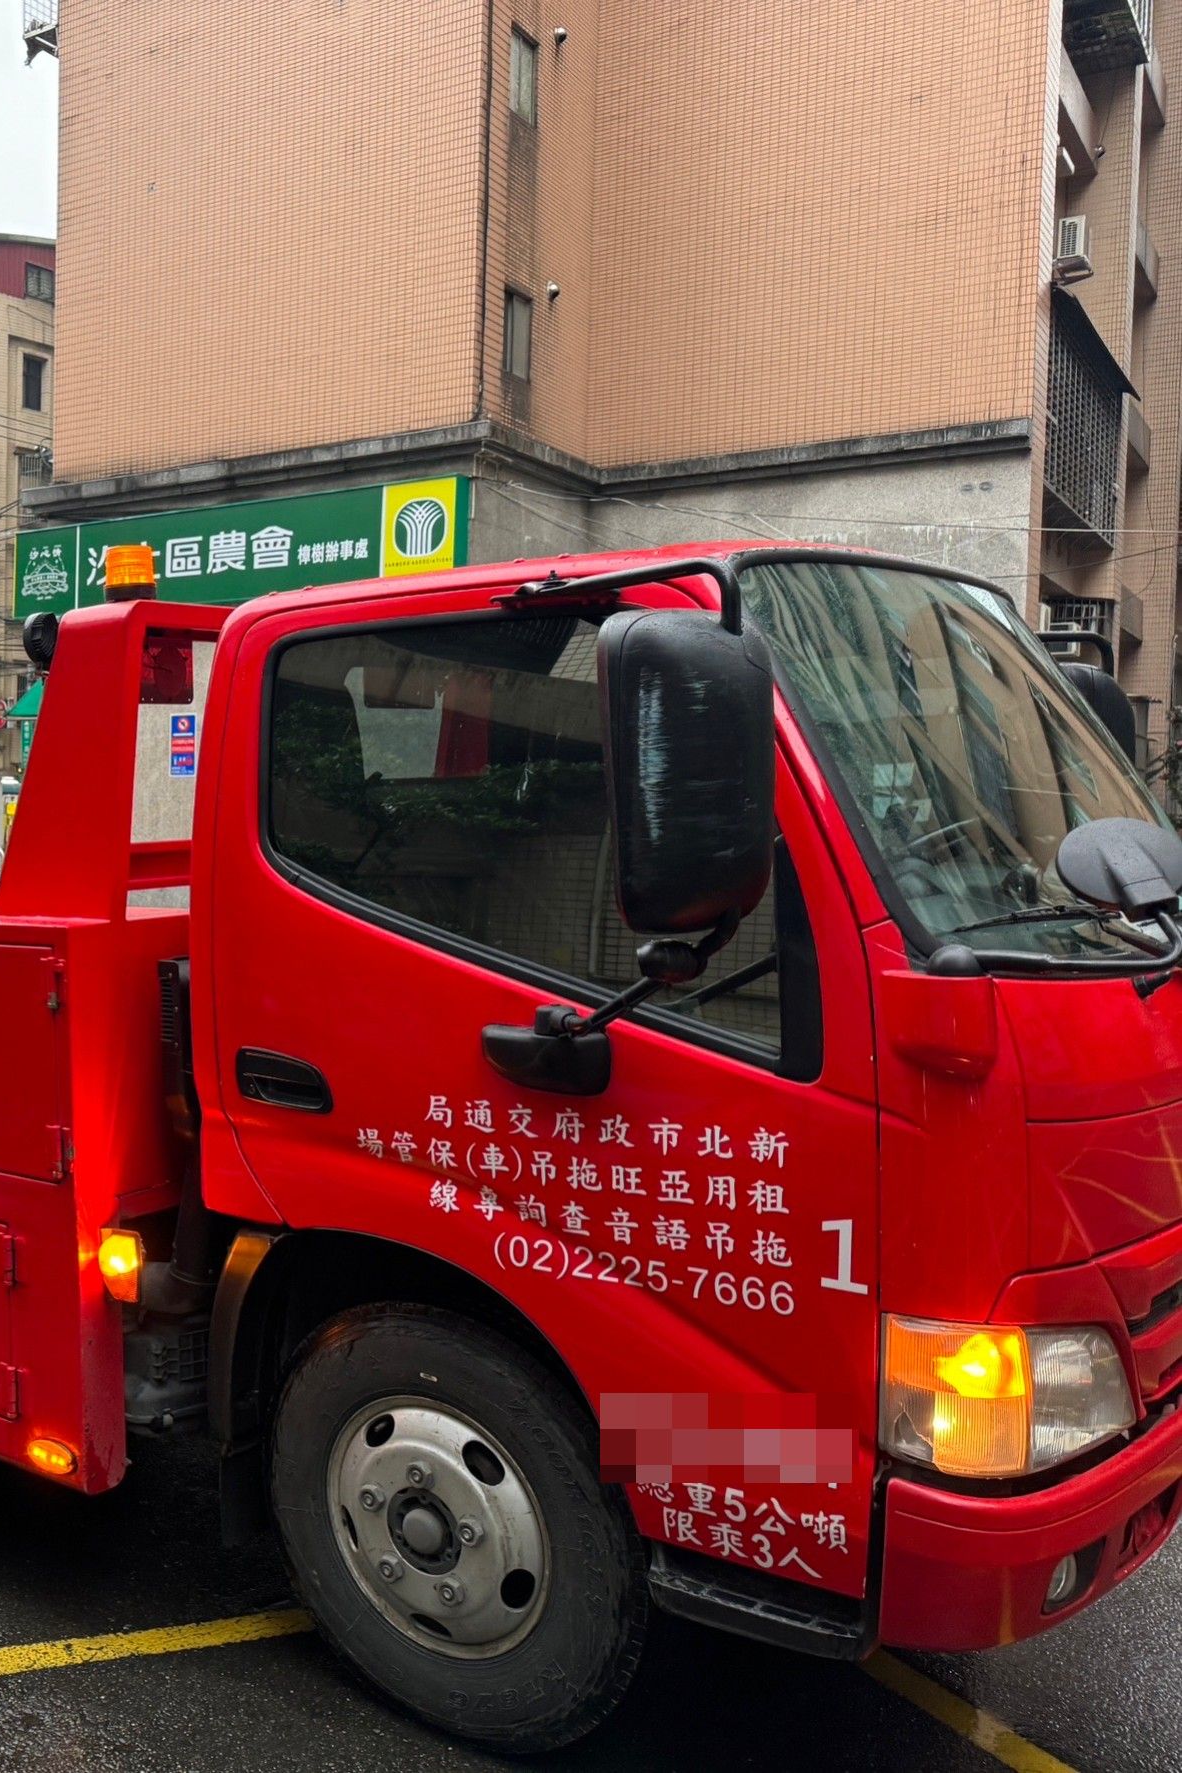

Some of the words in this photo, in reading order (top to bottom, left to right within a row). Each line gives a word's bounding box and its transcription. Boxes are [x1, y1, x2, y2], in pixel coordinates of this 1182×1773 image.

[297, 538, 369, 566] 樟樹辦事處
[493, 1231, 795, 1316] (02)2225-7666
[820, 1218, 870, 1296] 1
[663, 1506, 823, 1579] 限乘3人
